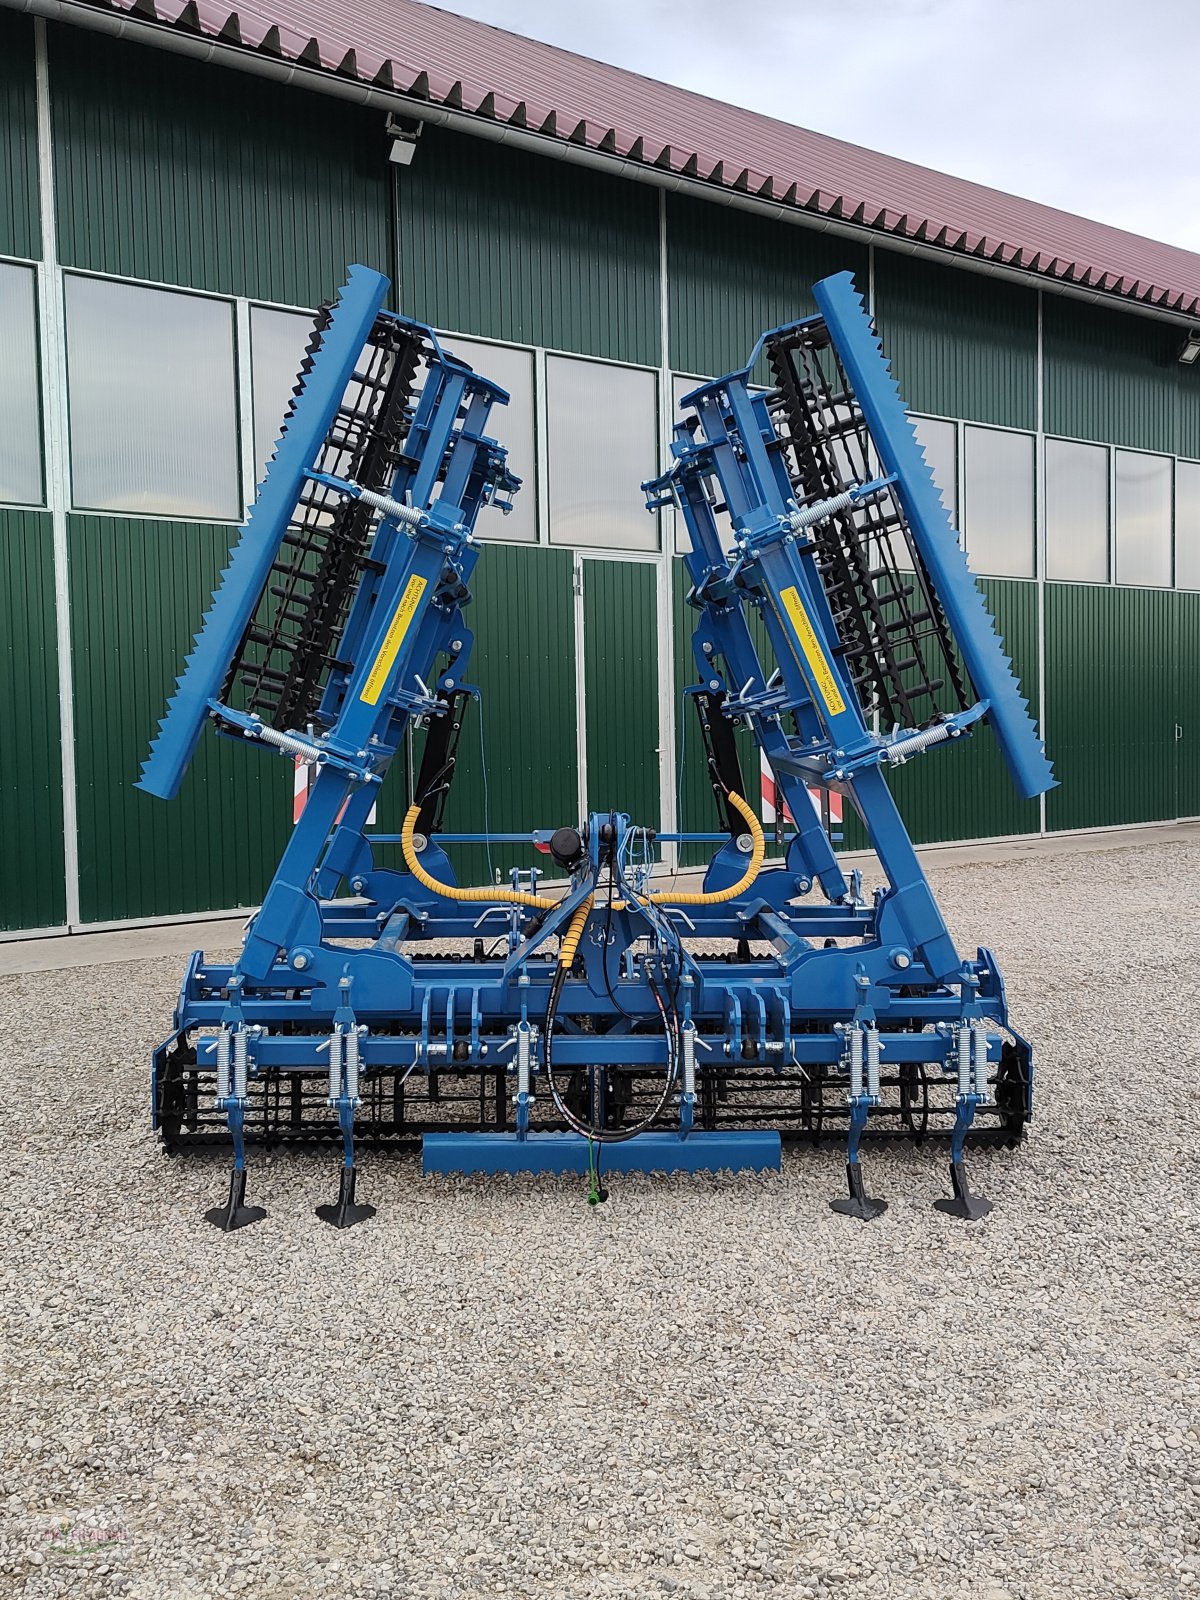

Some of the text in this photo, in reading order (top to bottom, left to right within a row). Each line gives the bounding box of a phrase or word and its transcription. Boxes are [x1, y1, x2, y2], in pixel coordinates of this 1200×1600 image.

[809, 638, 818, 650] den
[814, 649, 829, 675] Benutzen
[820, 680, 838, 712] ACHTUNG!
